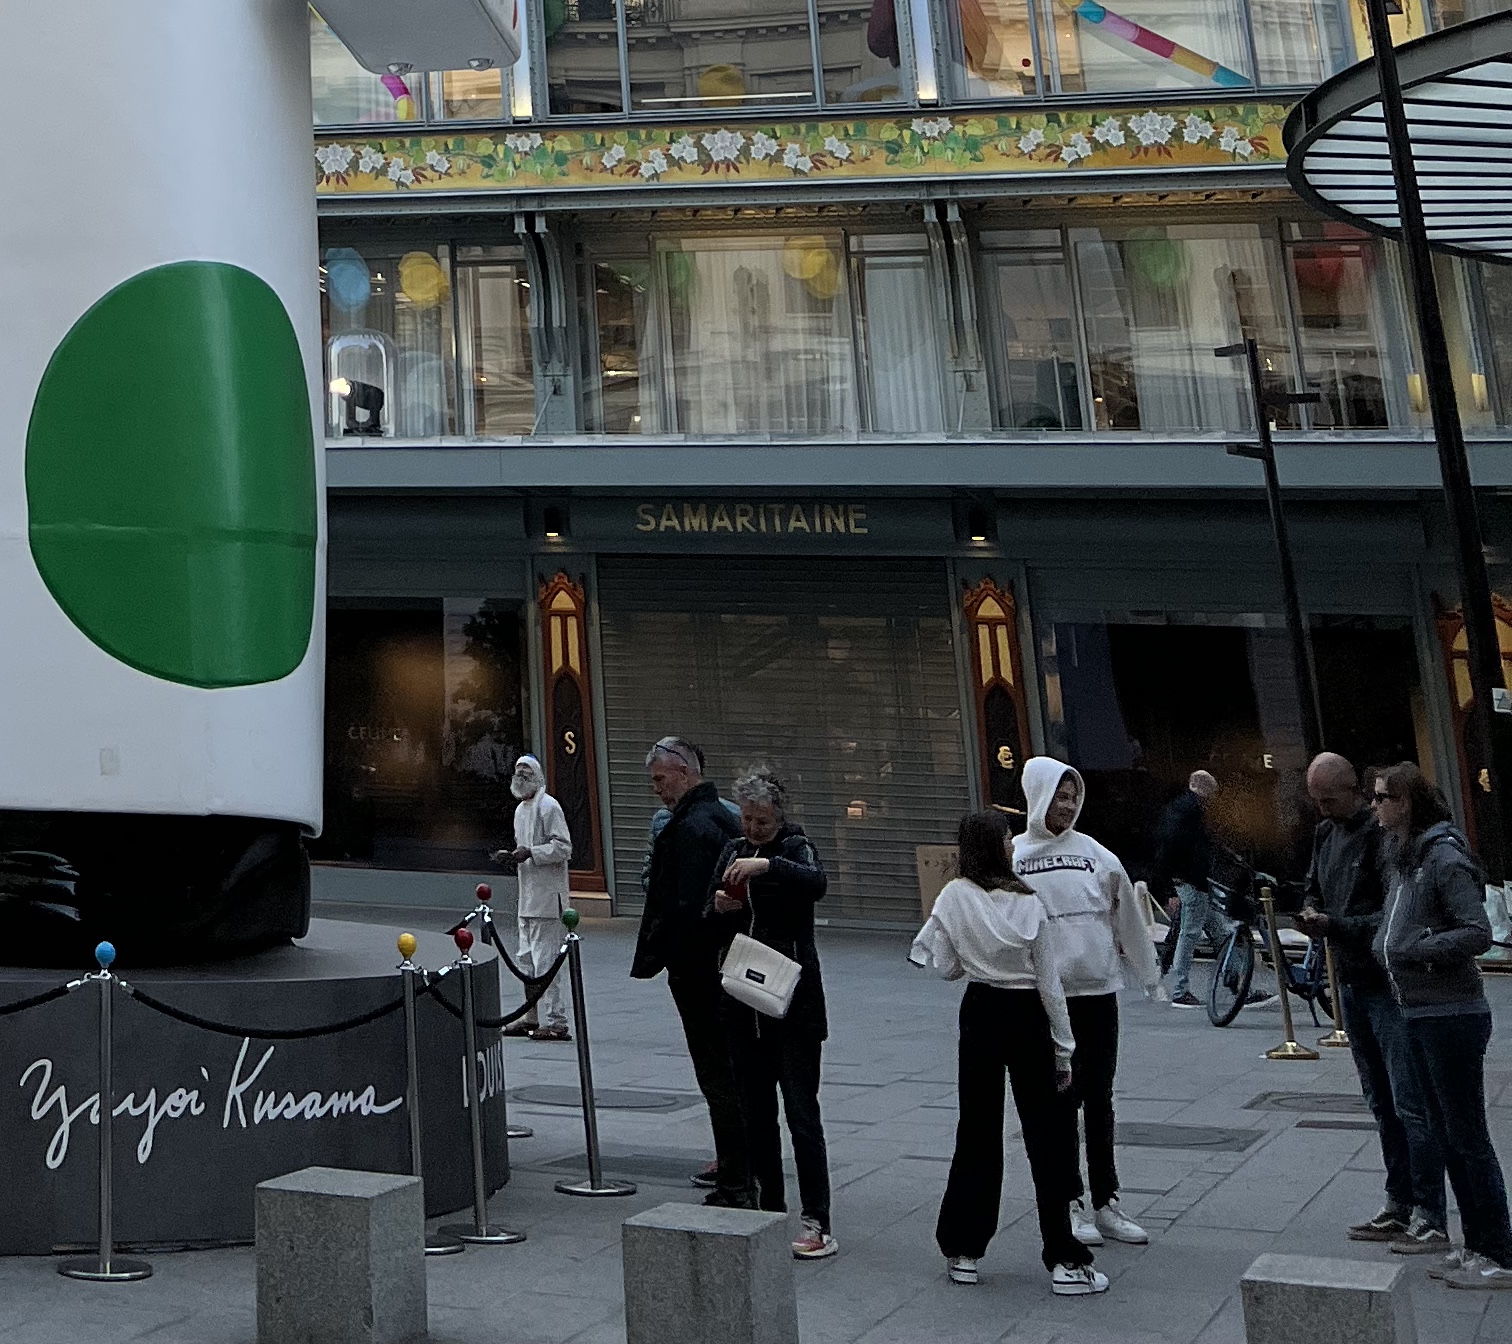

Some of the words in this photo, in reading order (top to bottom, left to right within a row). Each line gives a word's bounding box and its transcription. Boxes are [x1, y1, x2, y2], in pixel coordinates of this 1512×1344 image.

[636, 503, 869, 534] SAMARITAINE
[564, 731, 576, 754] S
[1016, 854, 1096, 875] MINECRAFT
[222, 1036, 402, 1129] Kusama
